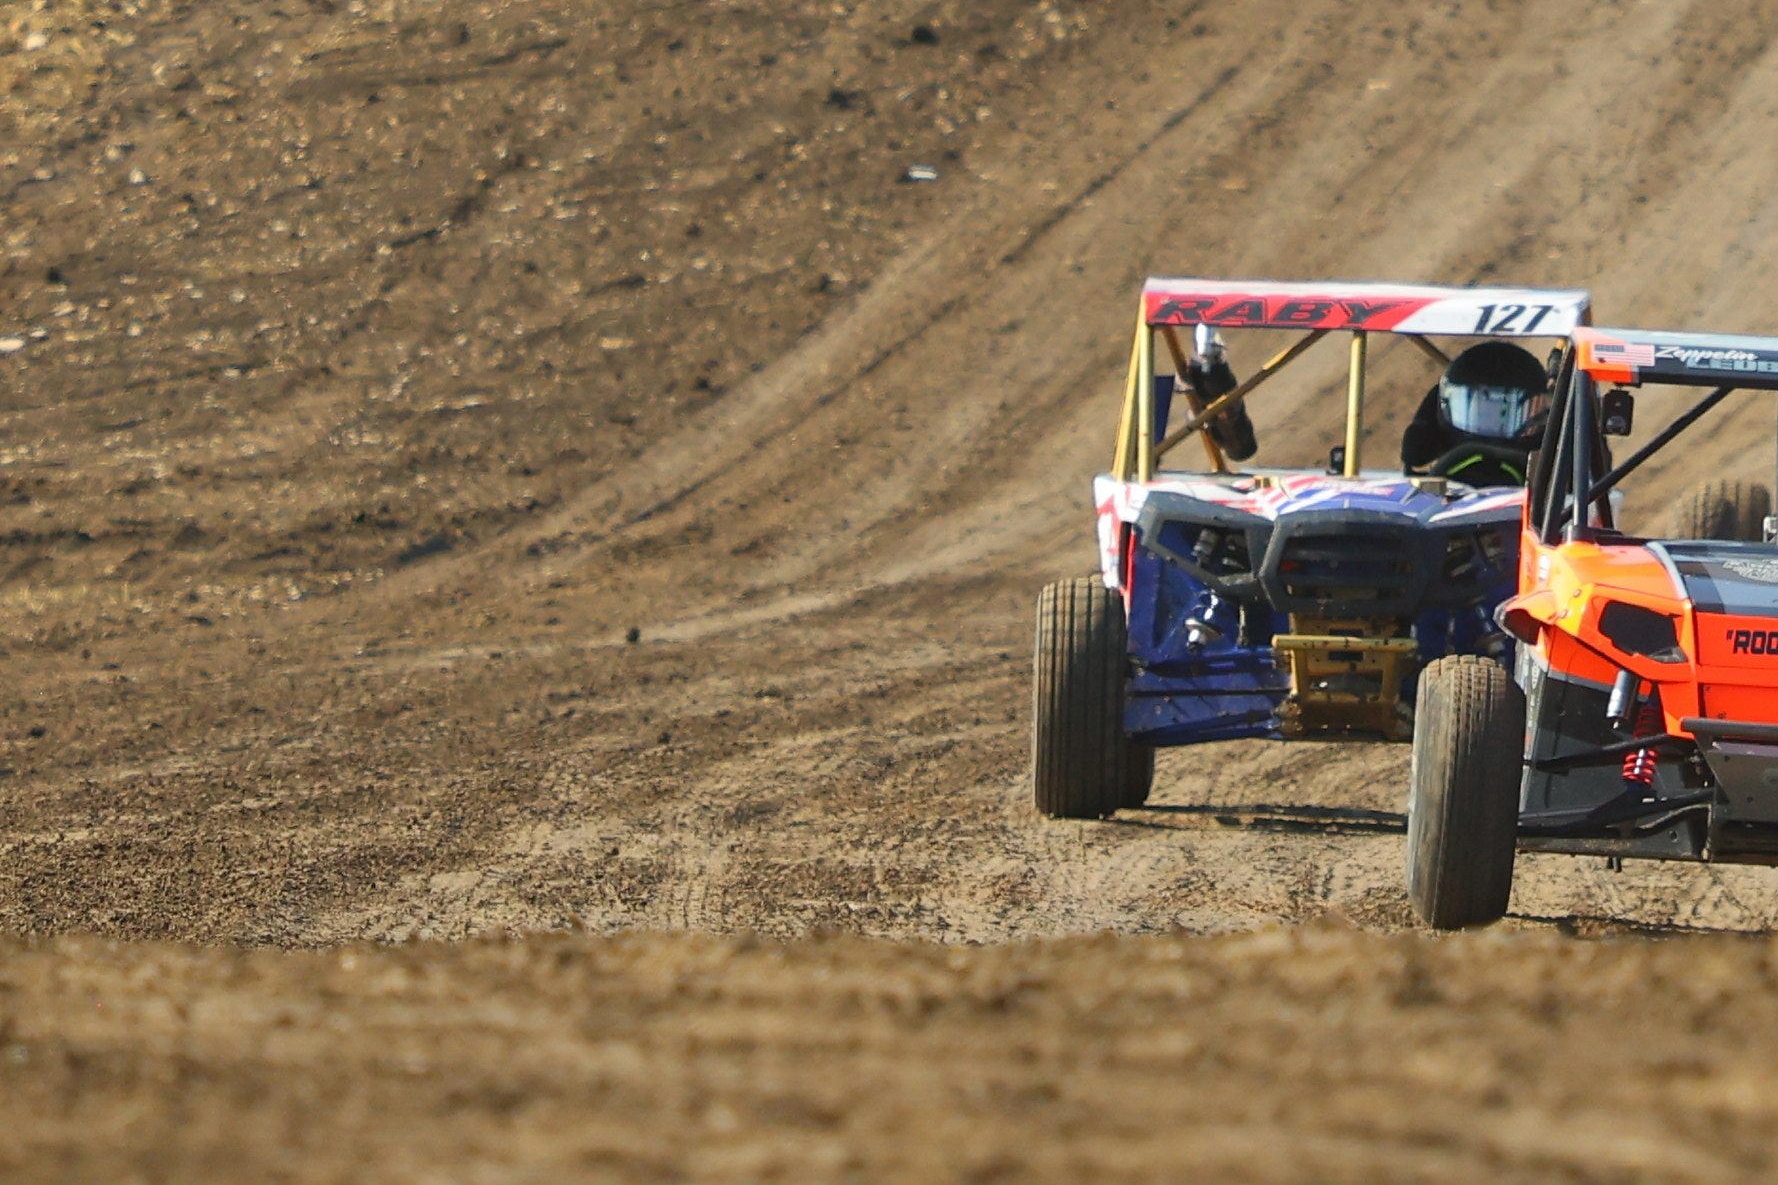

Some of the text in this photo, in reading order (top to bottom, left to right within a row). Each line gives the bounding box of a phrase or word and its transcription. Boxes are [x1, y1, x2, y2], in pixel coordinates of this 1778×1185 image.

[1150, 296, 1414, 327] RABY
[1474, 303, 1553, 335] 127
[1655, 345, 1759, 363] Zeppelin
